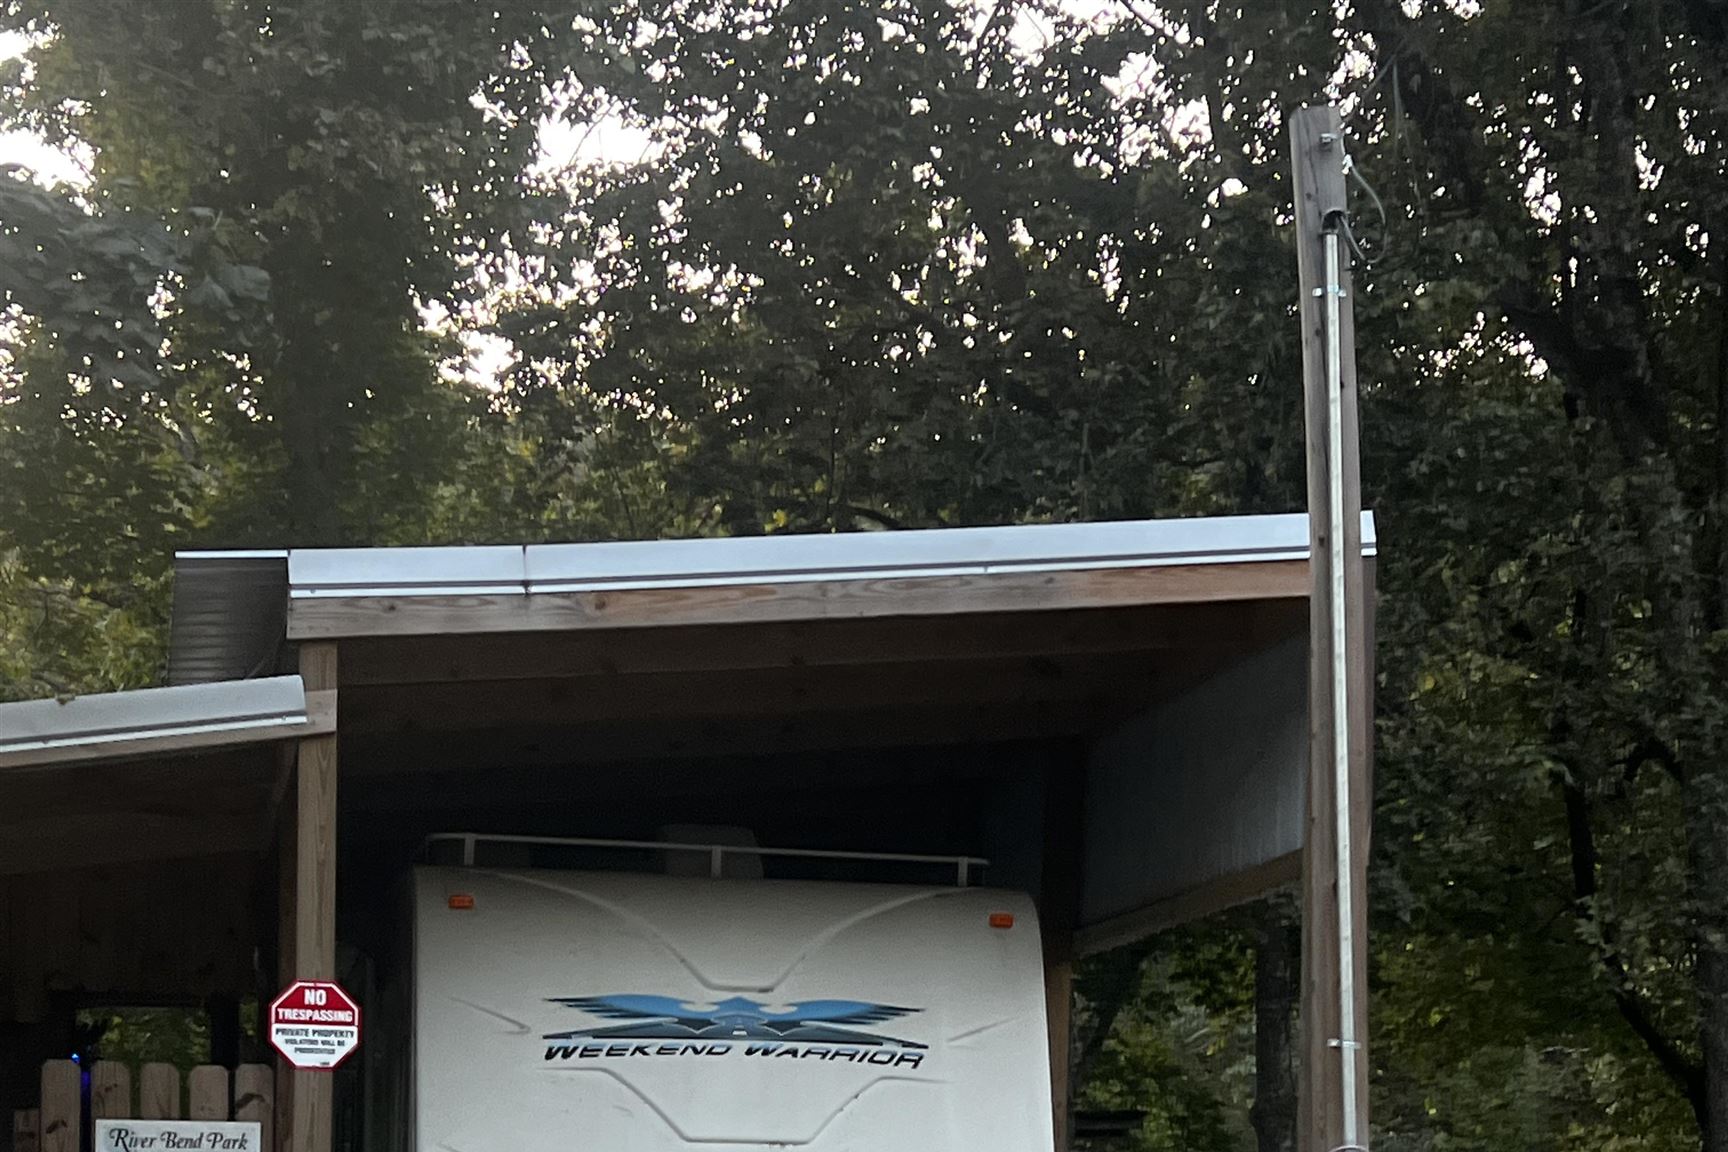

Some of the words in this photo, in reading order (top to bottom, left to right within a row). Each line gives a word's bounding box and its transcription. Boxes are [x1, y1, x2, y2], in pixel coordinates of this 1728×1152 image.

[304, 988, 327, 1006] NO
[277, 1008, 353, 1023] TRESPASSING
[276, 1028, 309, 1037] PRIVATE
[312, 1029, 354, 1038] PROPERTY
[544, 1038, 732, 1061] WEEKEND
[744, 1041, 924, 1070] WARRIOR
[160, 1131, 203, 1149] Bend
[206, 1133, 248, 1150] Park
